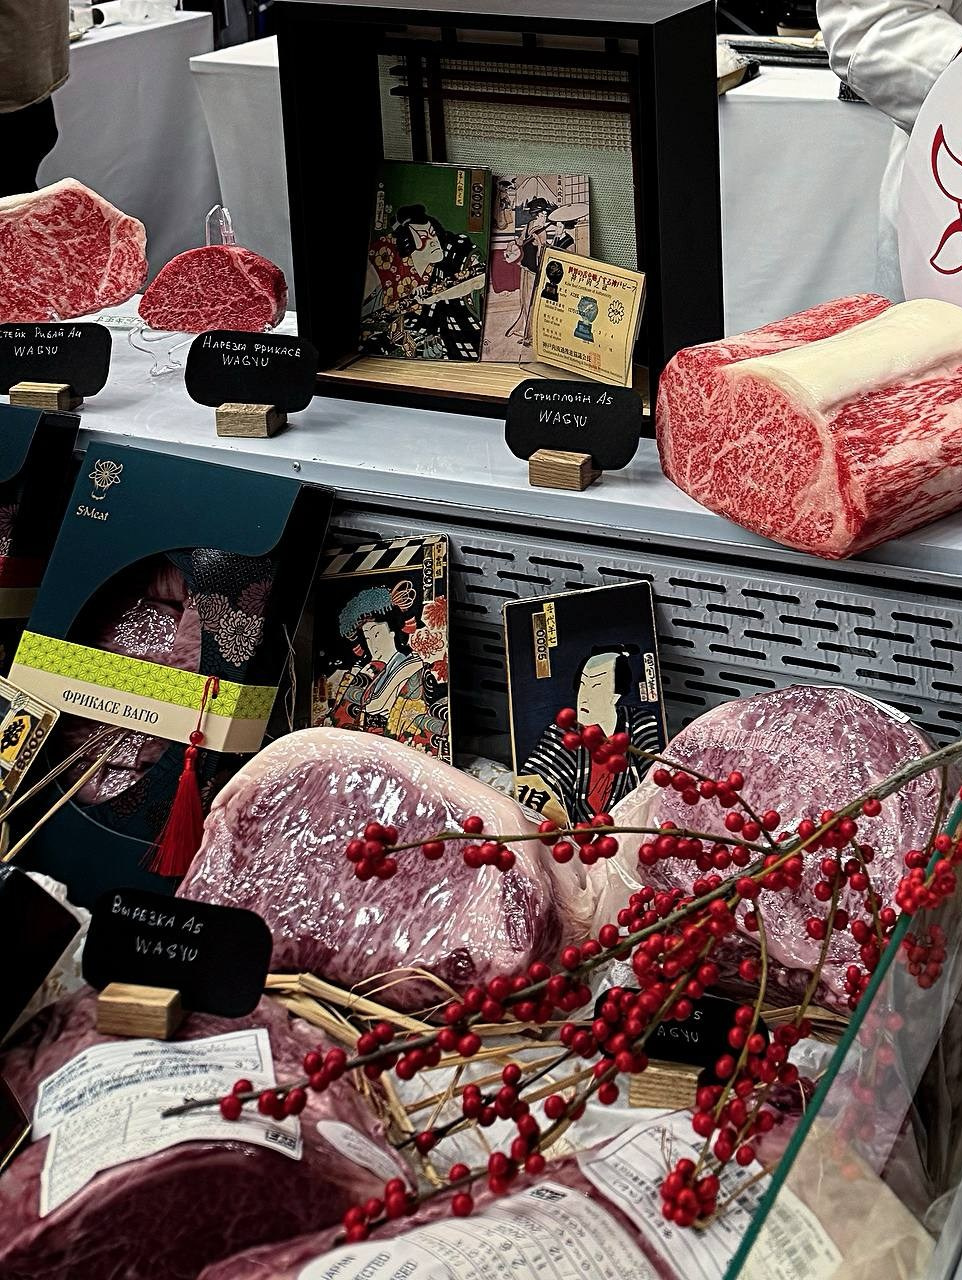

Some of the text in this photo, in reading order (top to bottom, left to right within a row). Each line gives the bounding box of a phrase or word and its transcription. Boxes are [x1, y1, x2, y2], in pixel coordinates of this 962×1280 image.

[14, 345, 59, 357] WAGYU
[222, 353, 269, 367] WAGYU
[539, 409, 588, 428] WAGYU
[536, 628, 548, 661] 0005
[62, 689, 159, 725] ФРИКАСЕ ВАГЮ
[657, 1025, 699, 1043] AGYU
